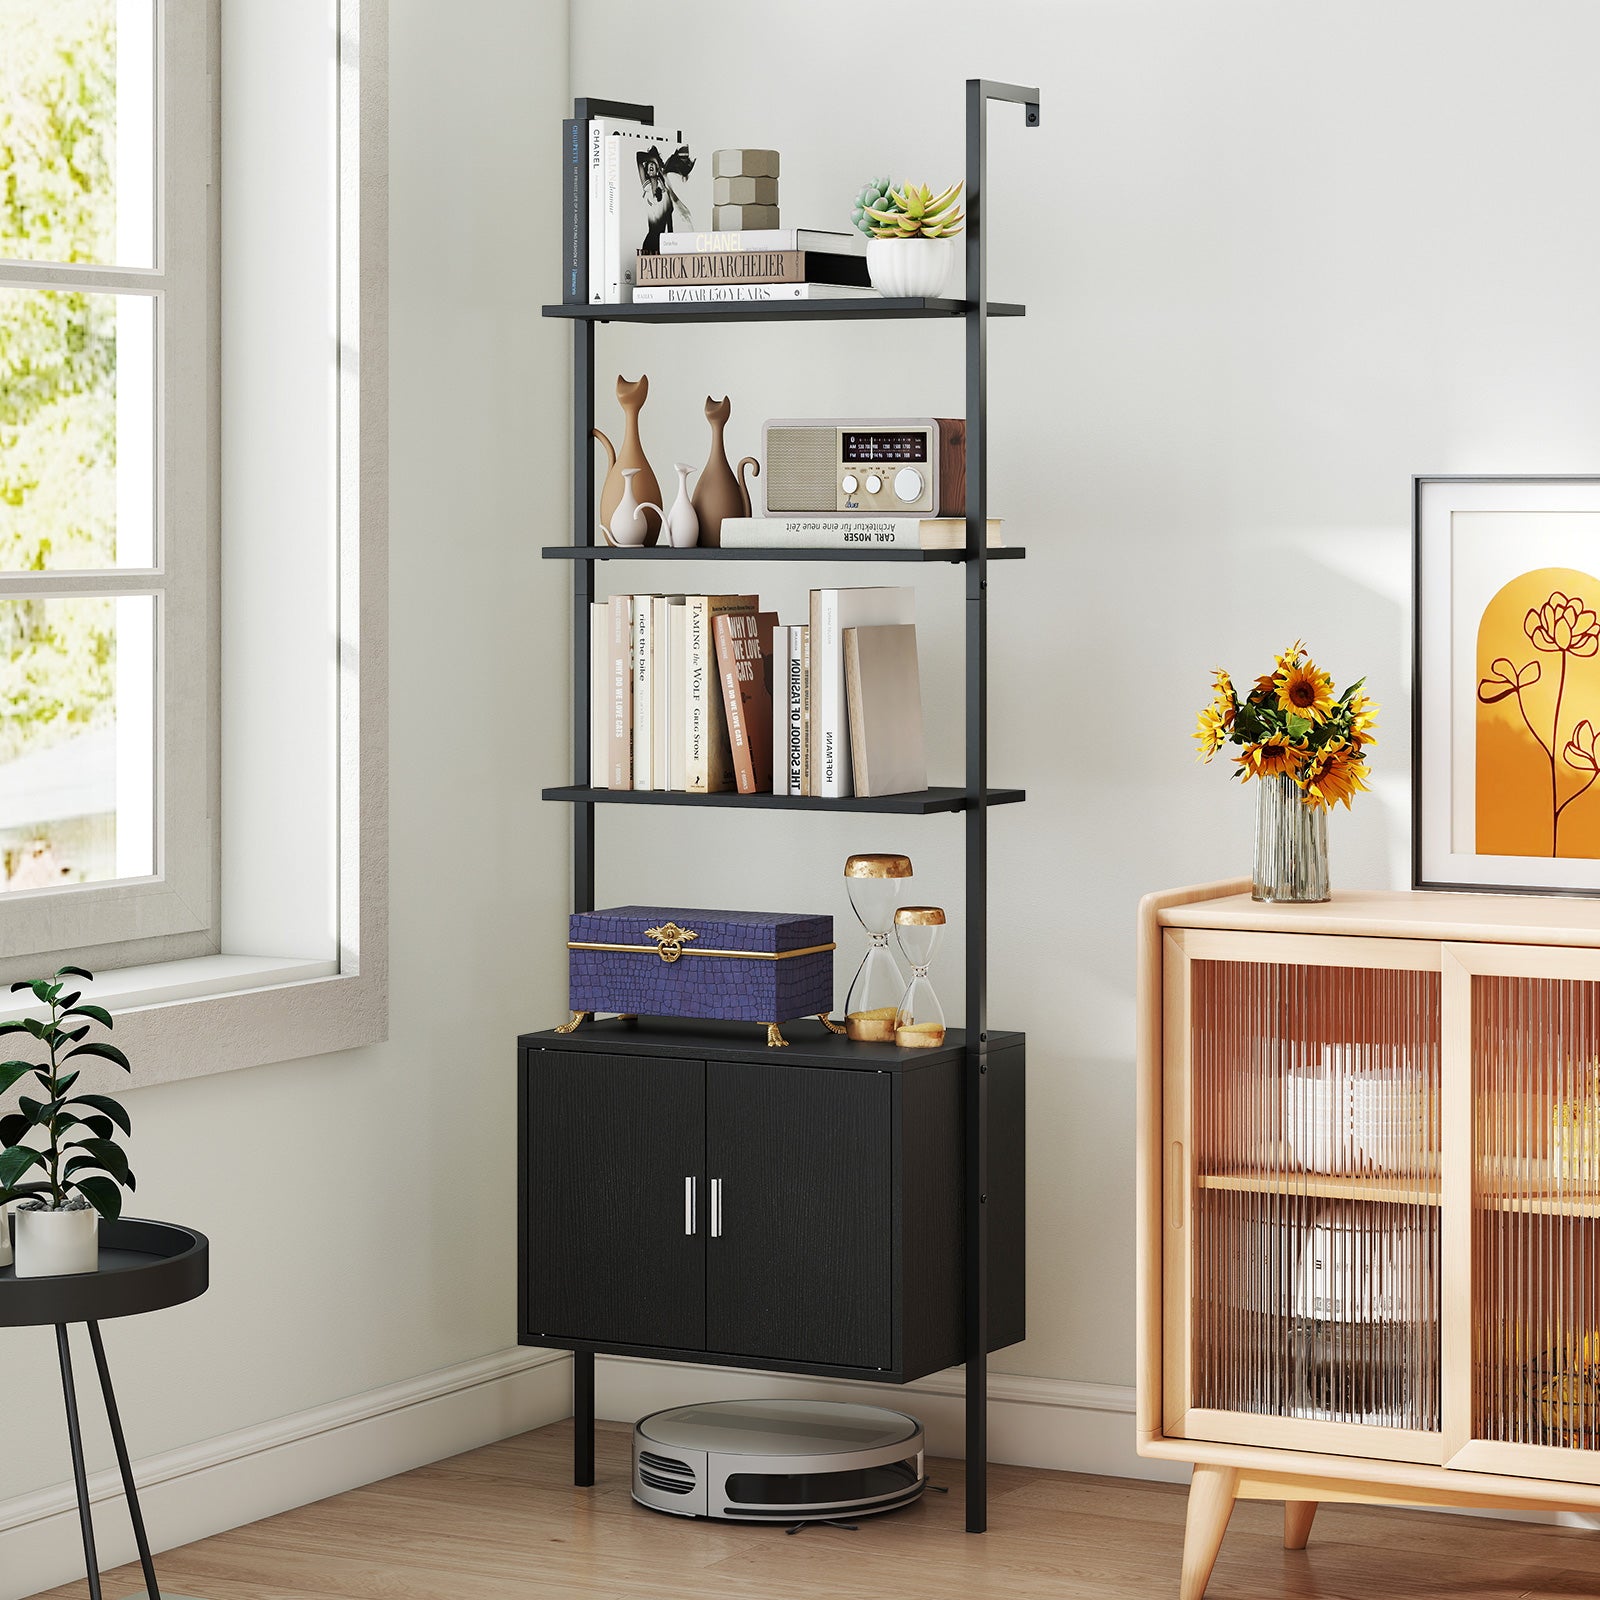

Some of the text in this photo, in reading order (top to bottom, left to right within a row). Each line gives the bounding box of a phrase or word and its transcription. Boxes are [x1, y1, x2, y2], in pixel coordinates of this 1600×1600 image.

[696, 232, 744, 252] CHANEL
[640, 256, 689, 280] PATRICK
[692, 254, 785, 279] DEMARCHELIER
[668, 288, 706, 302] BAZAAR
[709, 288, 727, 301] 150
[728, 287, 771, 300] YEARS
[786, 523, 896, 532] Architektur für eine neue Zeit
[844, 533, 895, 542] CARL MOSER
[693, 603, 702, 650] TAMING
[730, 616, 746, 638] WHY
[746, 616, 758, 638] DO
[733, 639, 763, 660] WE LOVE
[736, 661, 754, 681] CATS
[616, 677, 623, 687] DO
[693, 668, 702, 701] WOLF
[616, 688, 623, 699] WE
[693, 708, 701, 732] GREG
[726, 673, 743, 746] WHY DO WE LOVE CATS
[693, 734, 701, 761] STONE
